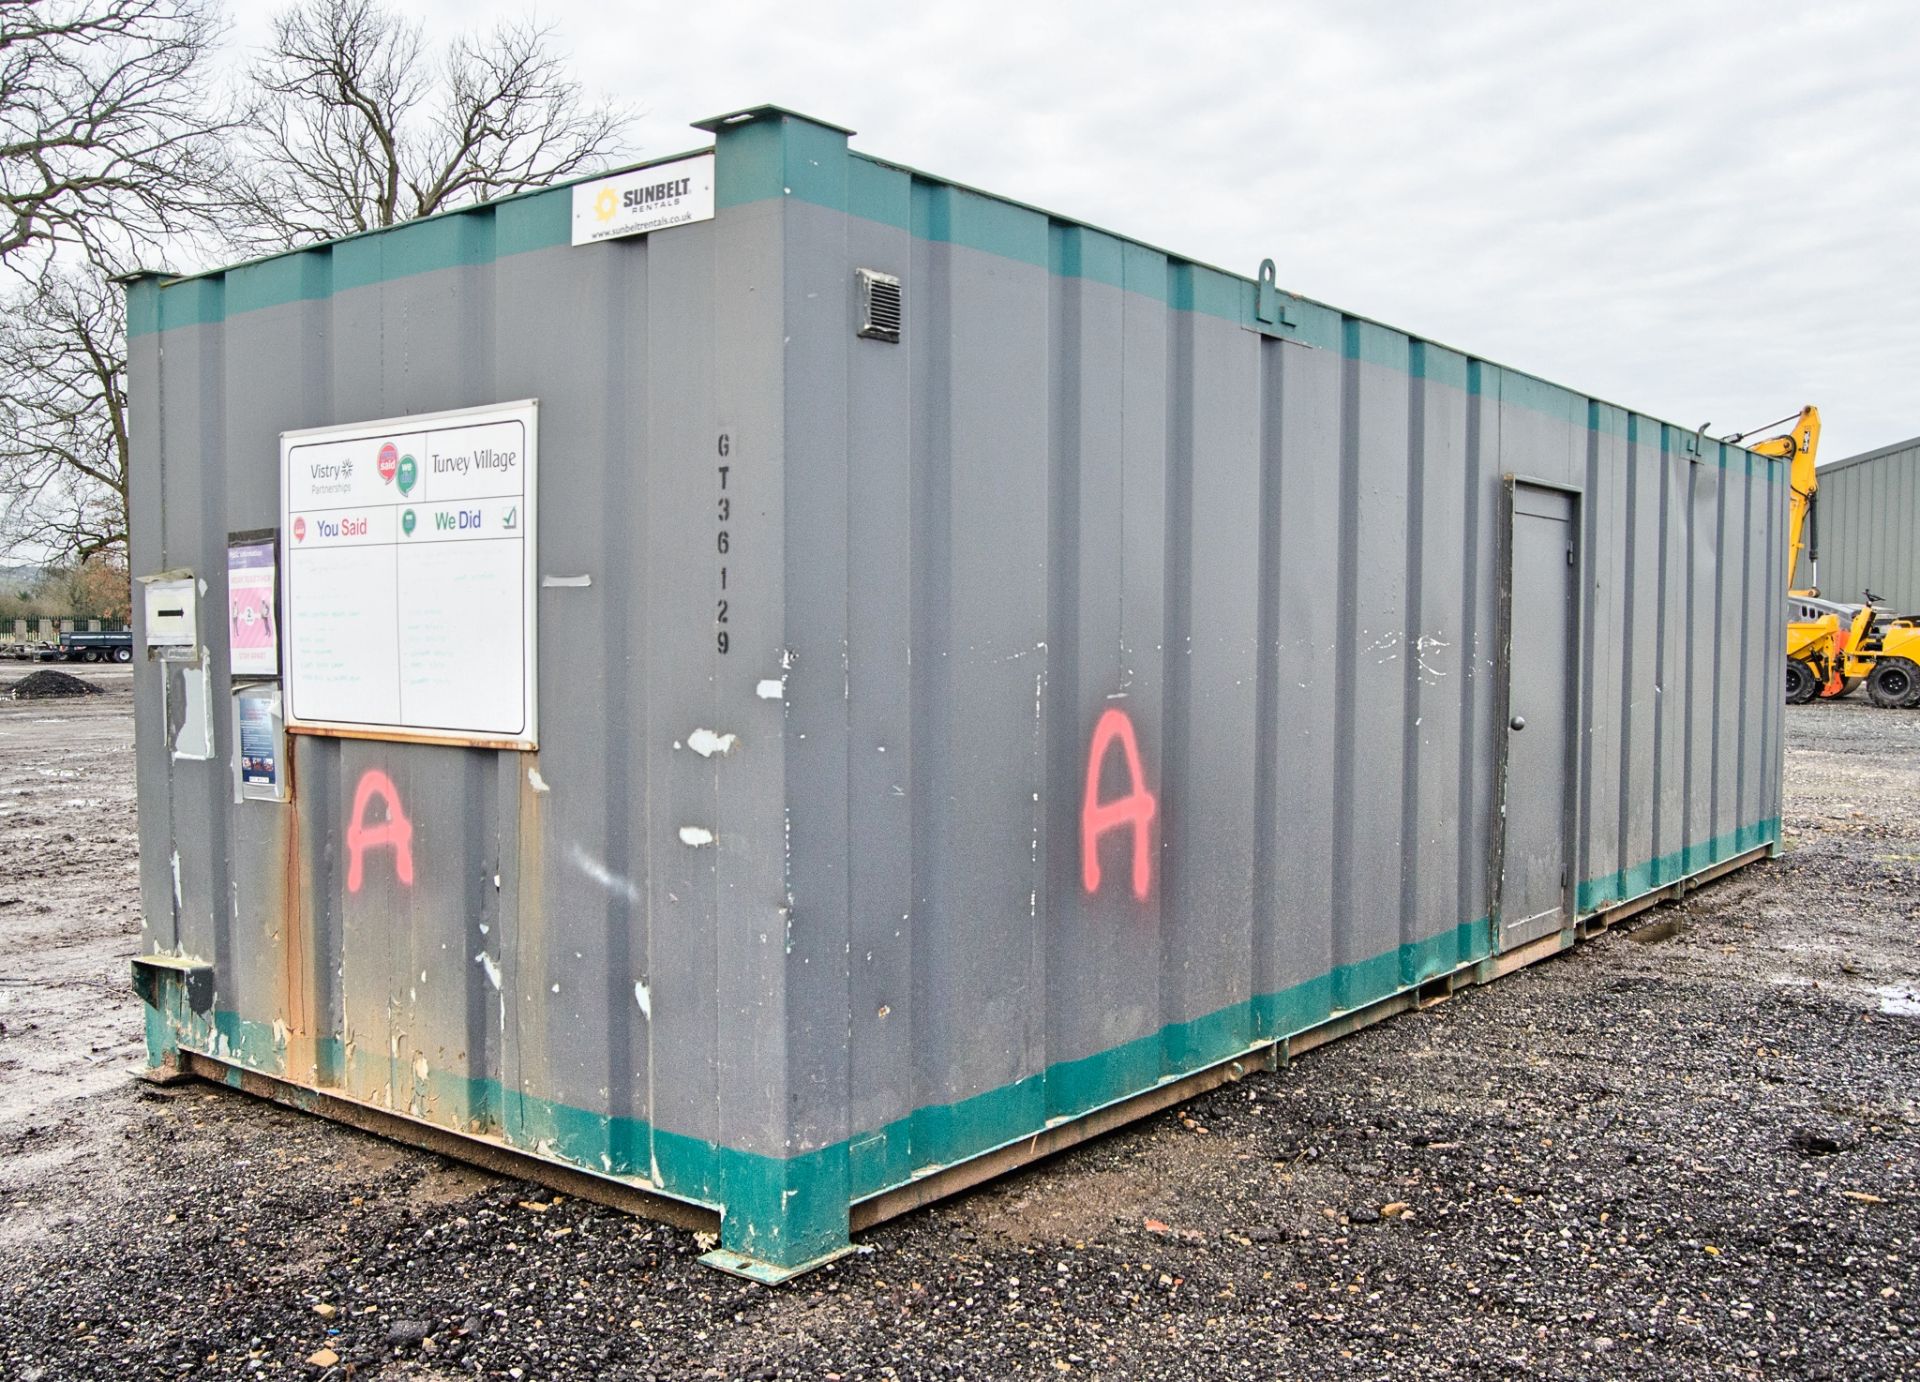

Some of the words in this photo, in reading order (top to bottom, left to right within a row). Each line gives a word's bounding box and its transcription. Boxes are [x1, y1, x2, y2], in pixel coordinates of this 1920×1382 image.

[623, 177, 690, 208] SUNBELT
[632, 198, 680, 213] RENTALS
[592, 211, 692, 239] www.sunbeltrentals.co.uk
[310, 463, 340, 480] Vistry
[431, 453, 471, 476] Turvey
[473, 449, 517, 473] Village
[311, 483, 351, 495] Partnerships
[317, 518, 339, 538] You
[341, 517, 367, 537] Said
[435, 511, 456, 531] We
[459, 509, 481, 530] Did
